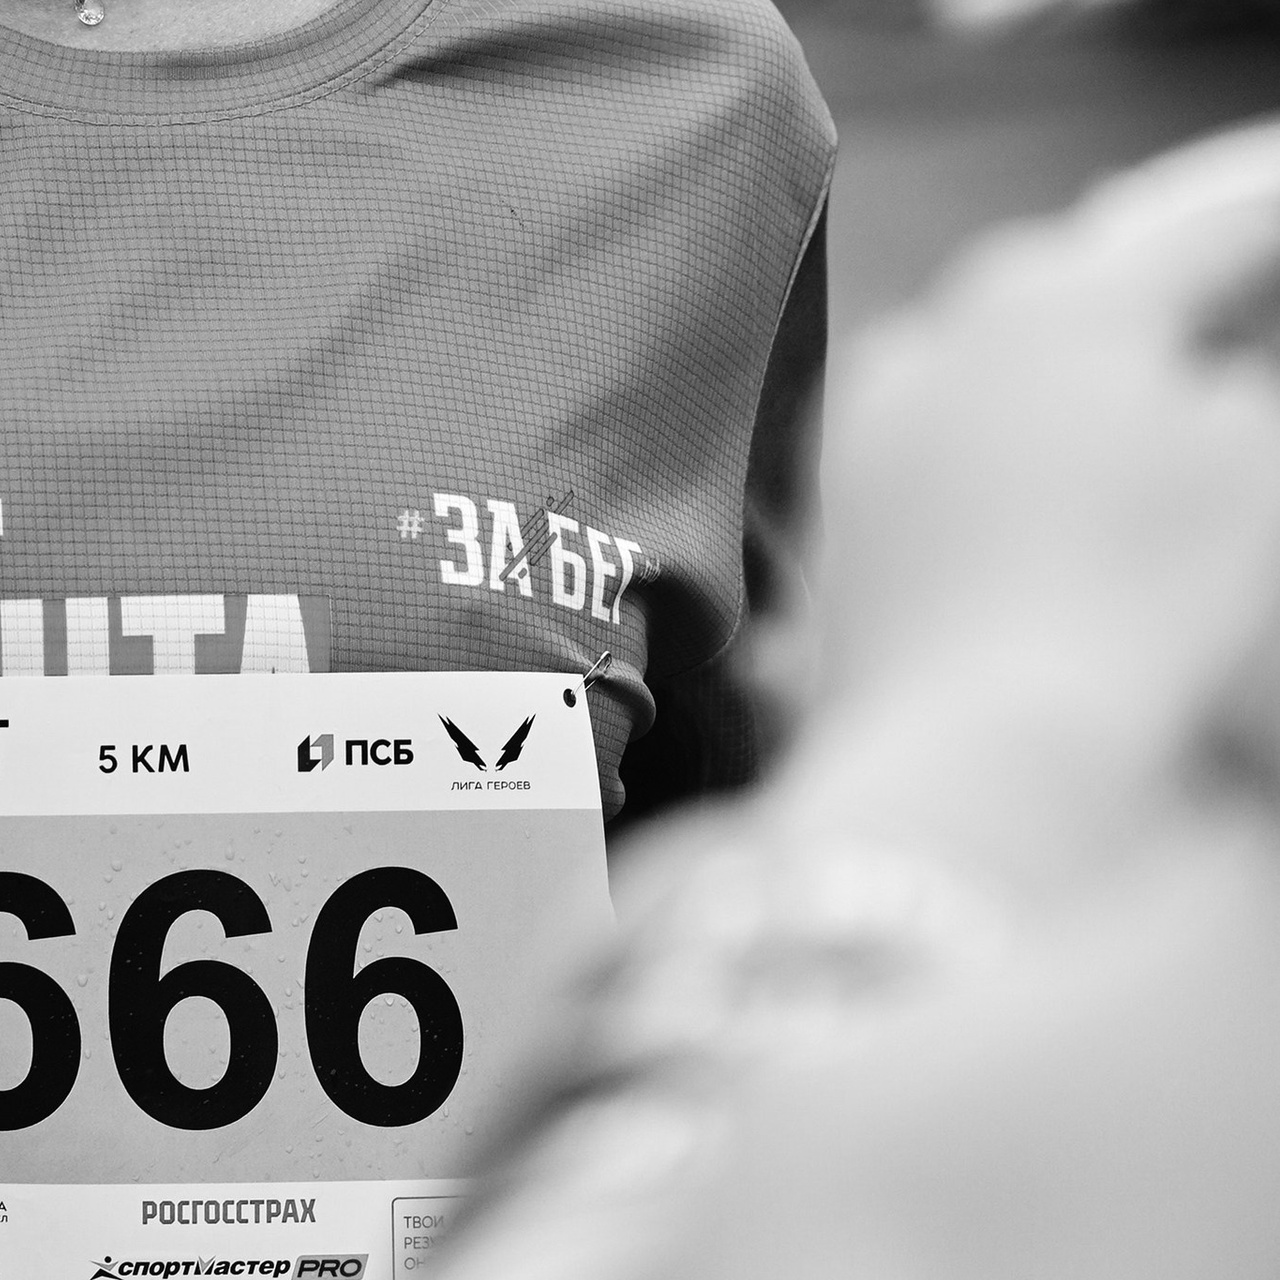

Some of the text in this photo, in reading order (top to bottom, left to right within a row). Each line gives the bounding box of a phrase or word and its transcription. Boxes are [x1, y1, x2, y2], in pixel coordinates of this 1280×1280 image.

[99, 744, 190, 774] 5 КМ
[345, 739, 414, 766] ПСБ
[451, 780, 531, 791] ЛИГА ГЕРОЕВ
[142, 1198, 317, 1225] РОСГОССТРАХ
[297, 1259, 363, 1278] PRO
